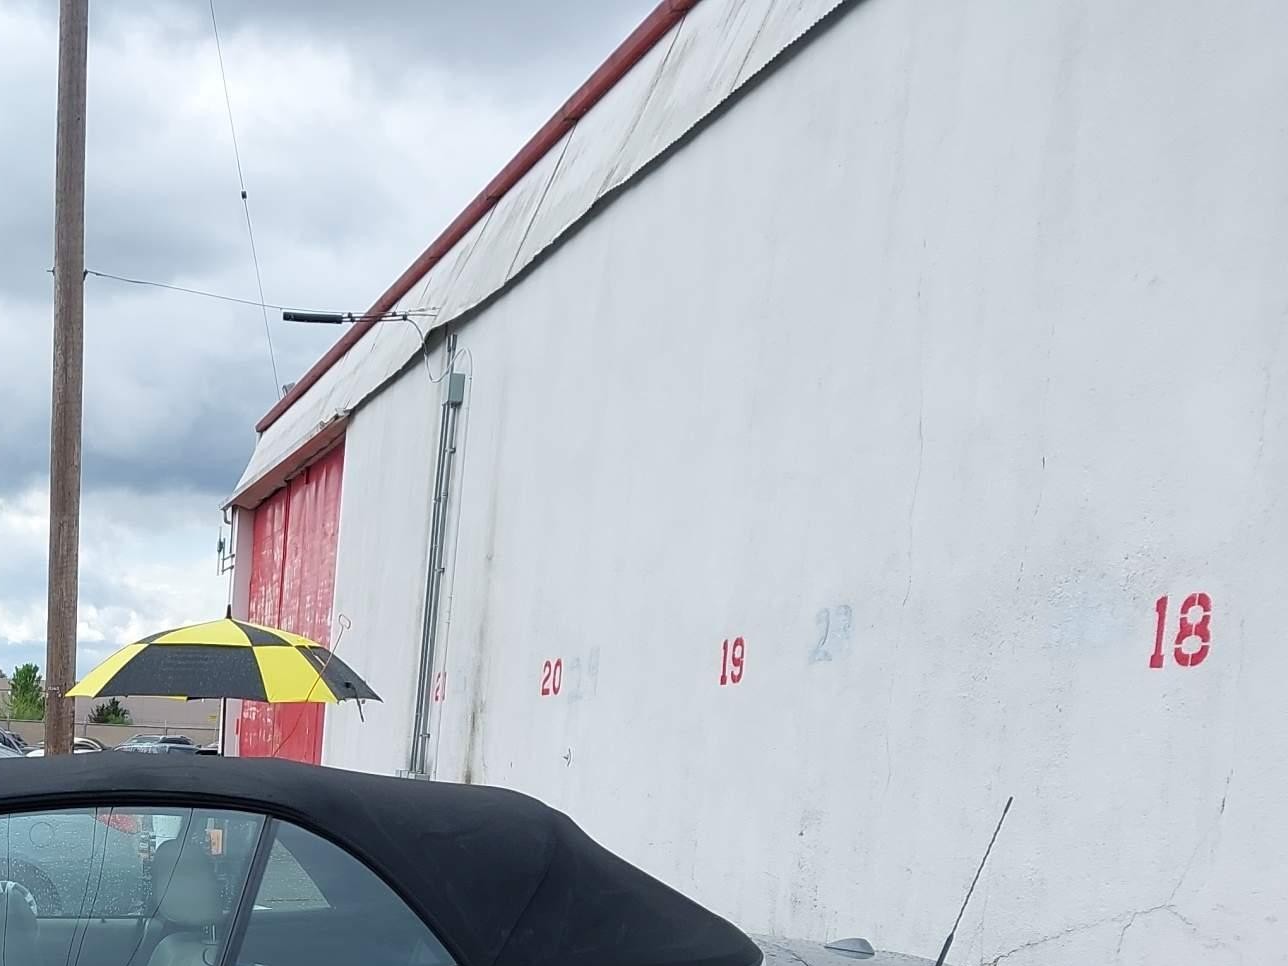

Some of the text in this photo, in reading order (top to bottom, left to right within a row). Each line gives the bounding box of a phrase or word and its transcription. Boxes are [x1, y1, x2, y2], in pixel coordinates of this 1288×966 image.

[1147, 591, 1213, 671] 18
[540, 657, 564, 697] 20
[718, 636, 746, 686] 19
